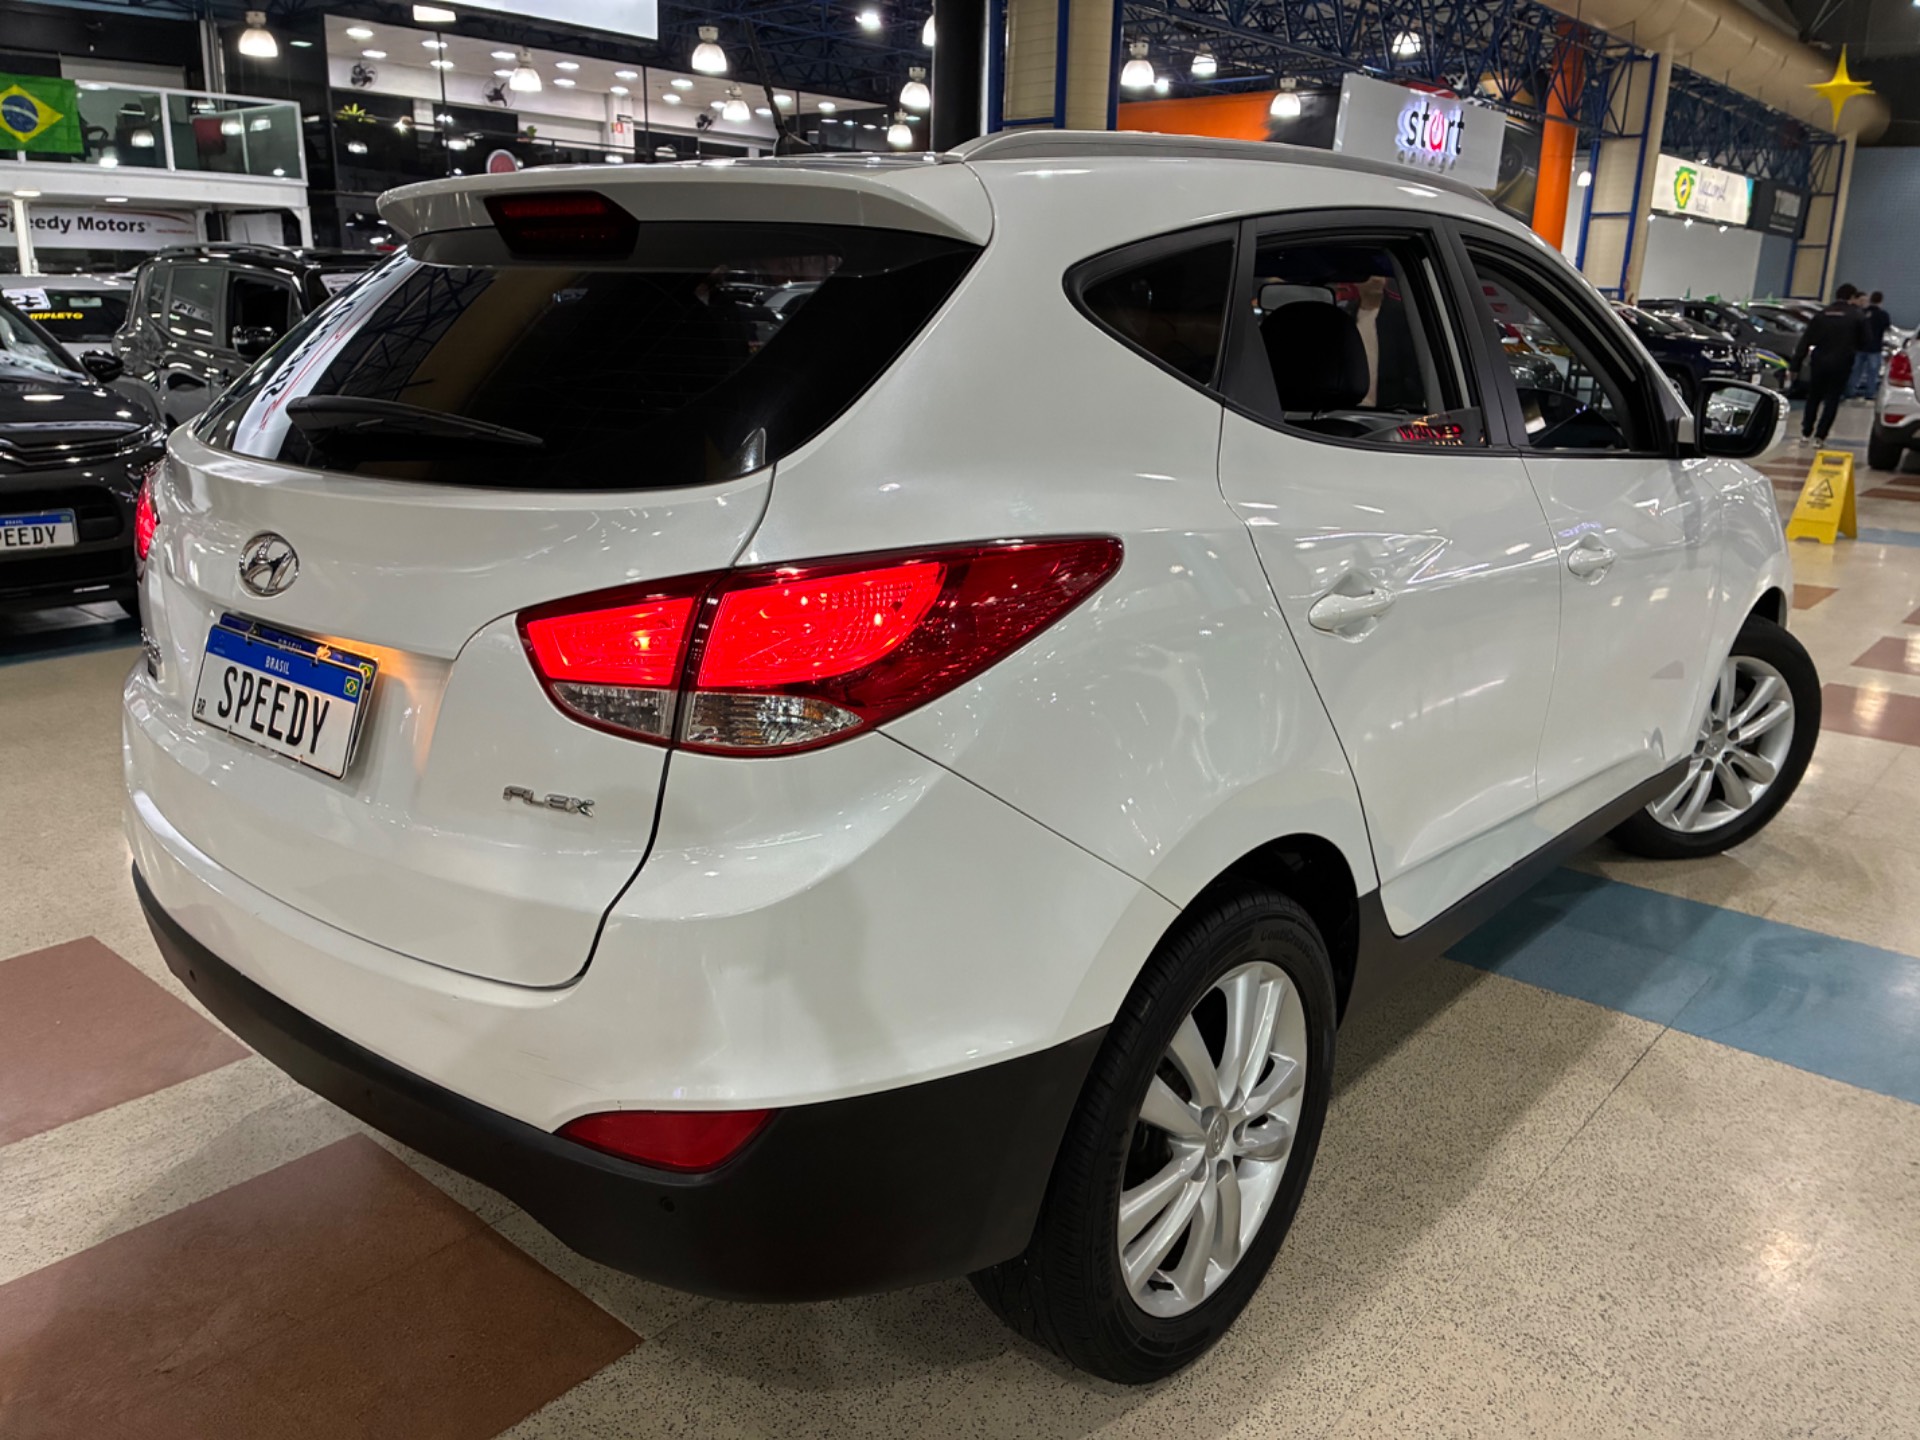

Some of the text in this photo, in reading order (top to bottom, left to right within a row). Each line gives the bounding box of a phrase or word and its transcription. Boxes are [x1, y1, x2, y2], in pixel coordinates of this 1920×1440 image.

[77, 216, 146, 233] Motors
[30, 312, 84, 320] MPLETO
[0, 525, 56, 547] EEDY
[265, 655, 290, 676] BRASIL
[218, 666, 330, 754] SPEEDY
